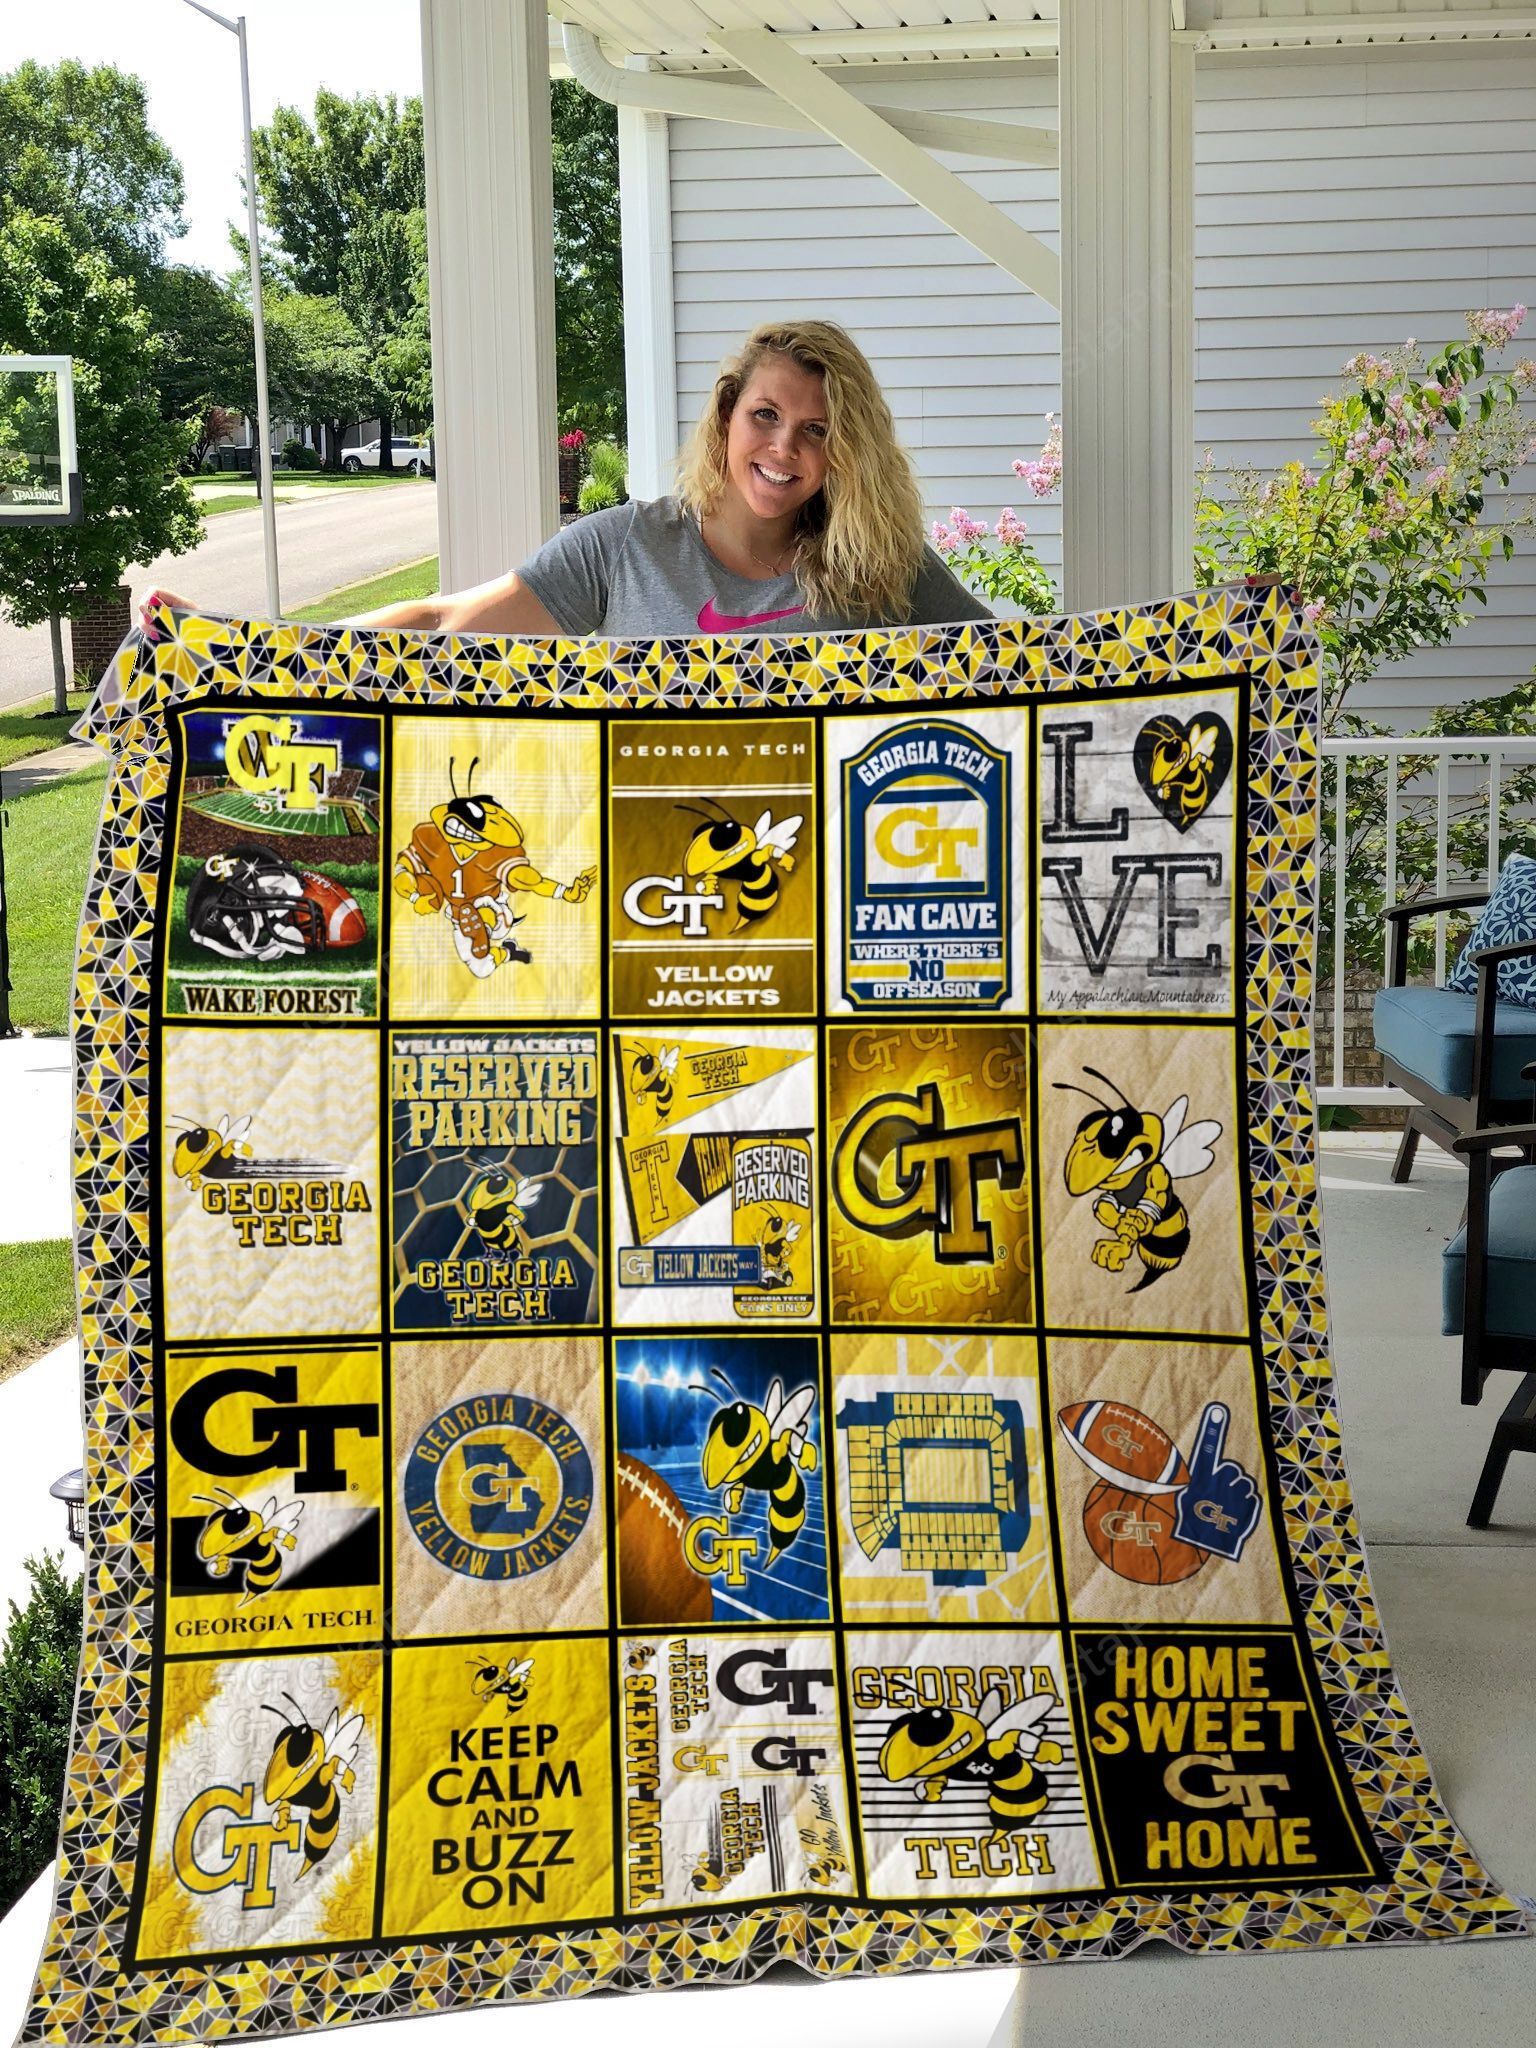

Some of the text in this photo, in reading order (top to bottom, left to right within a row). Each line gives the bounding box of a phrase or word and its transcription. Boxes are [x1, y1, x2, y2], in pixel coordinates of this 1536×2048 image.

[12, 490, 60, 501] SPALDING
[620, 743, 806, 757] GEORGIA TECH
[857, 740, 995, 787] GEORGIA TECH
[874, 805, 978, 878] GT
[451, 869, 465, 899] 1
[623, 875, 724, 936] GT
[855, 902, 997, 931] FAN CAVE
[854, 943, 998, 959] WHERE THERE'S
[909, 959, 945, 982] NO
[655, 965, 773, 983] YELLOW
[873, 982, 981, 998] OFFSEASON
[184, 986, 358, 1014] WAKE FOREST
[648, 989, 780, 1007] JACKETS
[1048, 989, 1068, 1010] My
[1147, 988, 1227, 1004] Mountaineers
[394, 1038, 596, 1054] YELLOW JACKETS
[691, 1050, 748, 1076] GEORGIA
[848, 1028, 900, 1073] GT
[392, 1054, 597, 1100] RESERVED
[702, 1069, 740, 1090] TECH
[409, 1101, 582, 1147] PARKING
[634, 1146, 664, 1162] GEORGIA
[734, 1145, 809, 1181] RESERVED
[831, 1081, 1025, 1266] GT
[202, 1181, 372, 1214] GEORGIA
[734, 1173, 810, 1210] PARKING
[232, 1214, 343, 1248] TECH
[417, 1258, 578, 1291] GEORGIA
[626, 1255, 652, 1278] GT
[657, 1254, 695, 1280] YELLOW
[697, 1252, 739, 1279] JACKETS
[445, 1289, 551, 1322] TECH
[740, 1303, 807, 1313] FANS ONLY
[889, 1270, 943, 1316] GT
[170, 1366, 380, 1494] GT
[416, 1397, 583, 1464] GEORGIA TECH
[1102, 1424, 1144, 1459] GT
[458, 1462, 540, 1512] GT
[1100, 1510, 1162, 1547] GT
[1193, 1499, 1238, 1533] GT
[410, 1496, 591, 1578] YELLOW JACKETS
[684, 1516, 758, 1586] GT
[175, 1609, 373, 1637] GEORGIA TECH
[668, 1638, 690, 1733] GEORGIA
[689, 1655, 710, 1716] TECH
[716, 1648, 835, 1715] GT
[852, 1666, 1064, 1709] GEORGIA
[1115, 1646, 1269, 1698] HOME
[450, 1724, 559, 1763] KEEP
[1091, 1701, 1306, 1754] SWEET
[672, 1744, 728, 1776] GT
[751, 1736, 827, 1777] GT
[427, 1760, 583, 1807] CALM
[625, 1674, 664, 1909] YELLOW JACKETS
[1163, 1754, 1290, 1817] GT
[470, 1806, 540, 1831] AND
[720, 1787, 745, 1876] GEORGIA
[742, 1802, 765, 1859] TECH
[172, 1782, 303, 1911] GT
[432, 1829, 575, 1875] BUZZ
[904, 1834, 1055, 1880] TECH
[1146, 1817, 1317, 1870] HOME
[462, 1871, 545, 1910] ON
